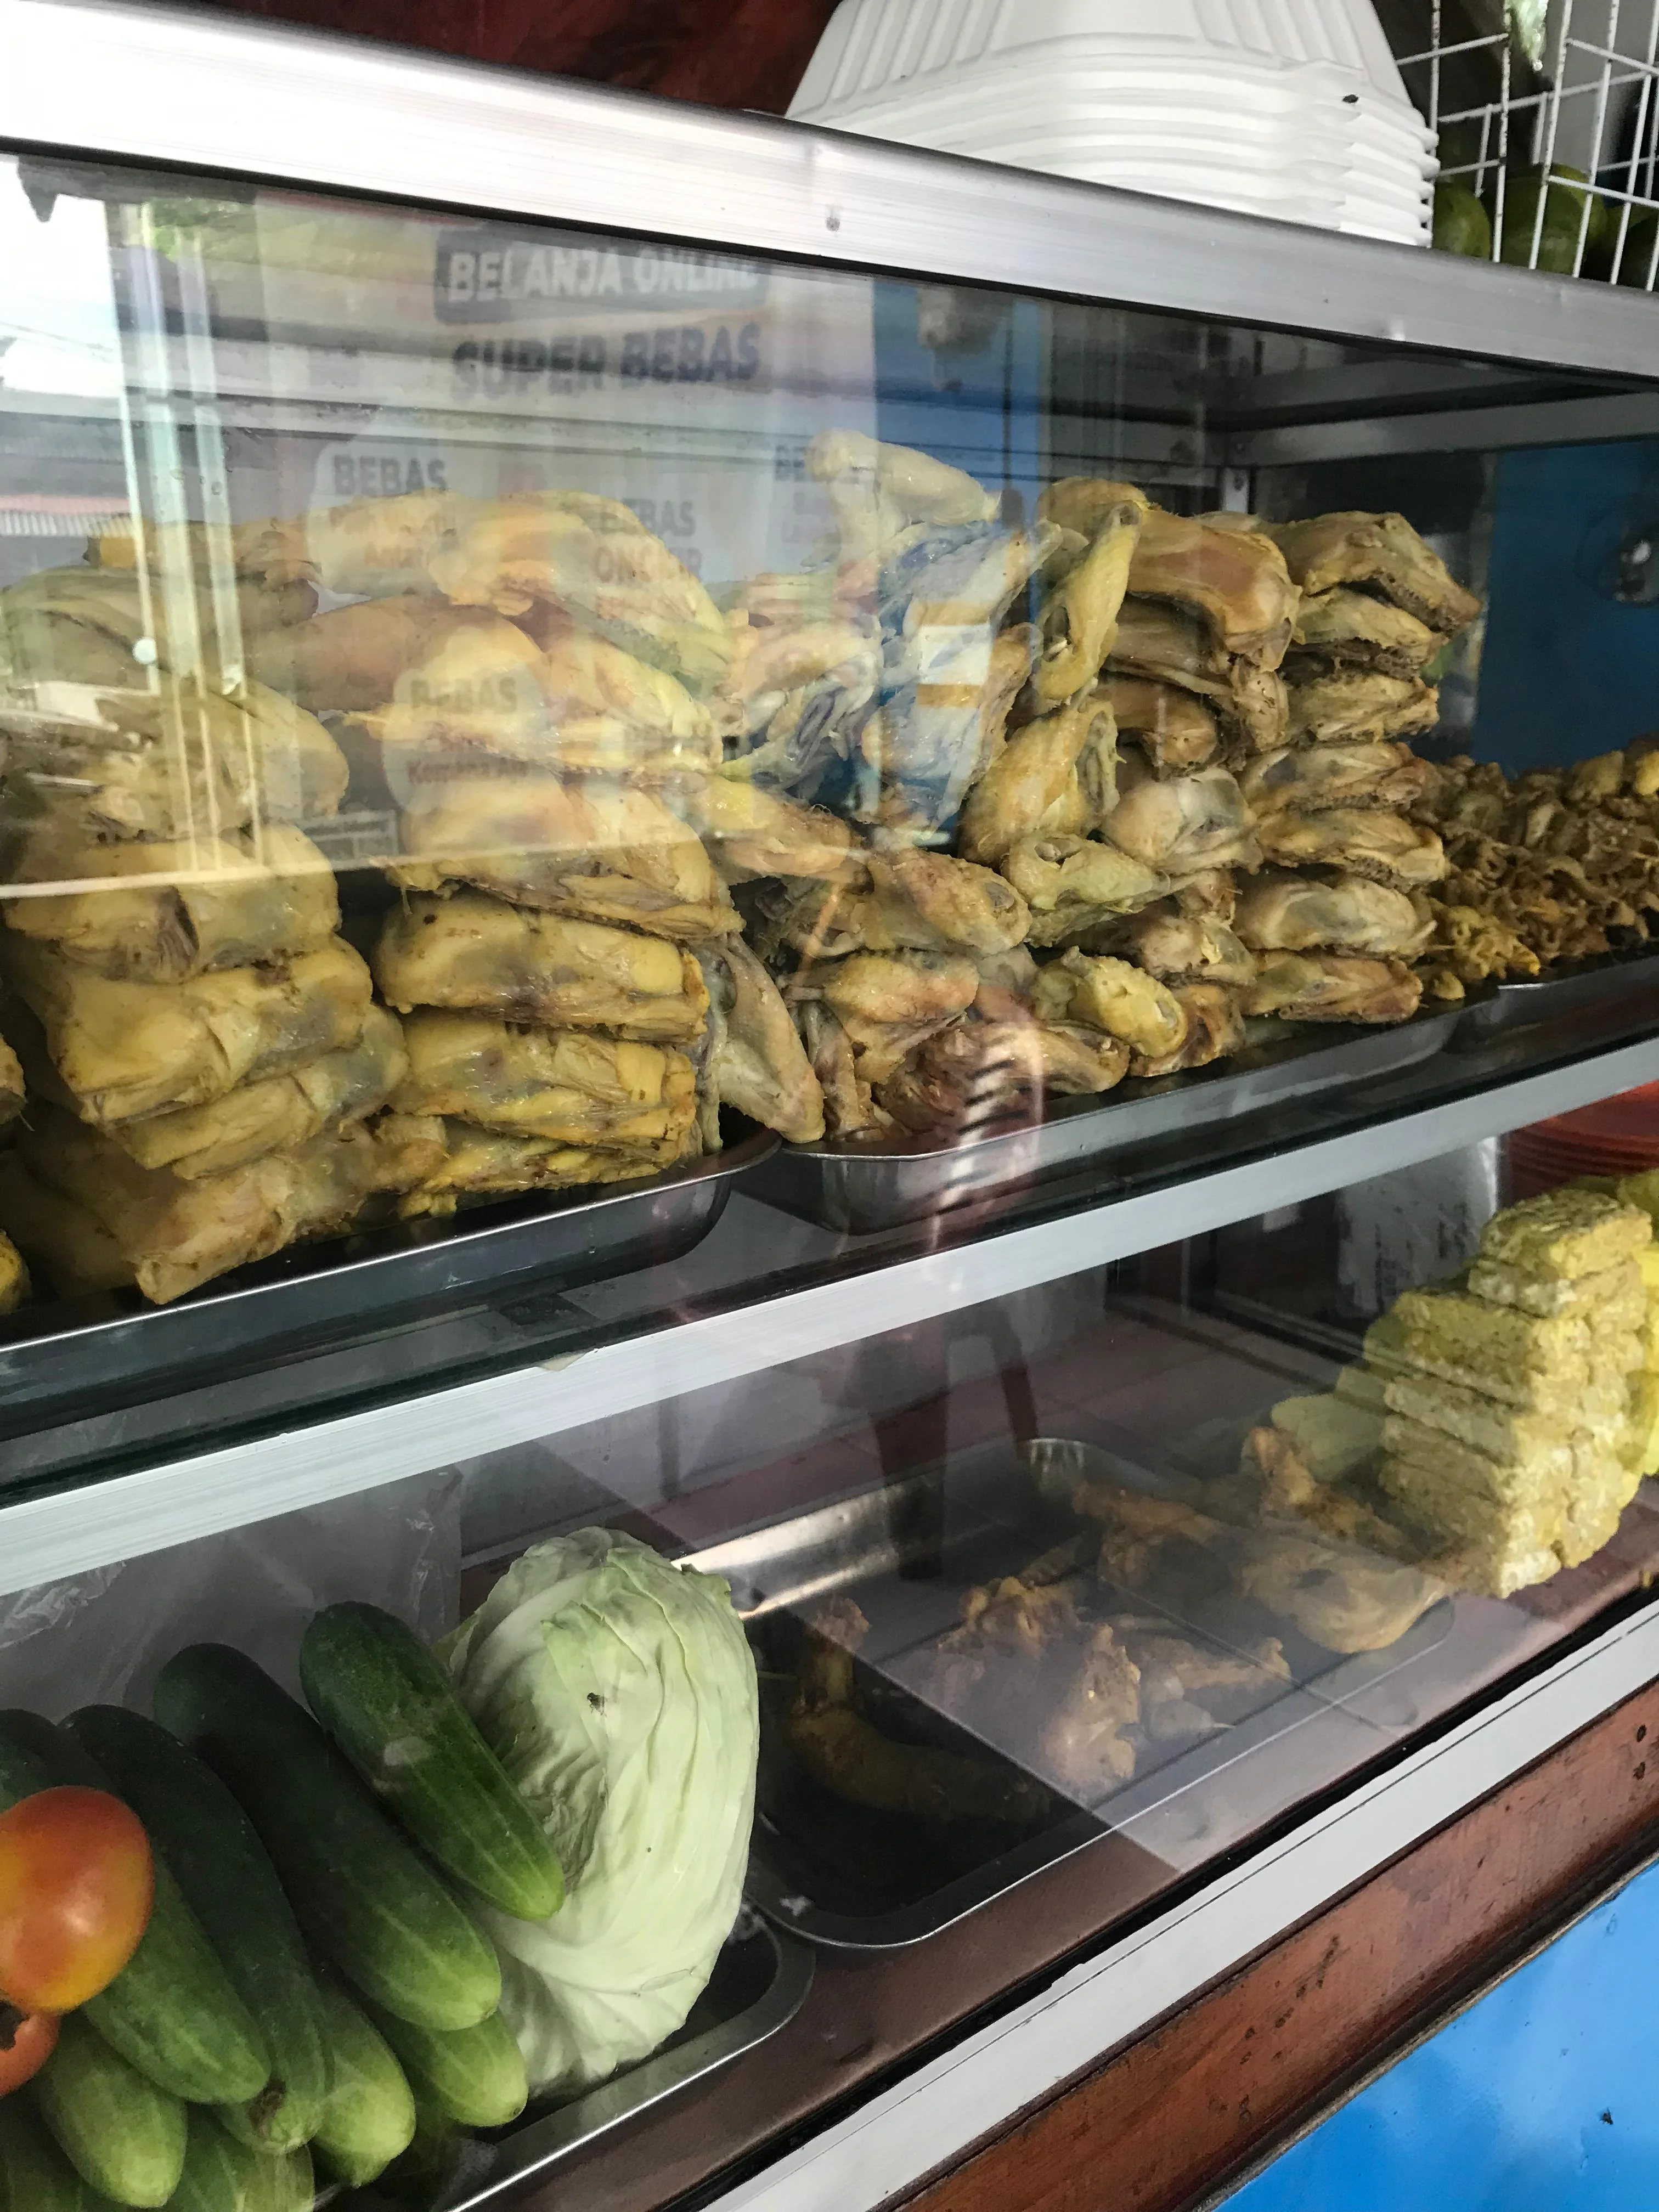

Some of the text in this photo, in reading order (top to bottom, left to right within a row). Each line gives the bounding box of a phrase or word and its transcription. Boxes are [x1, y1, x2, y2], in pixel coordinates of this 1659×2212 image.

[448, 246, 623, 303] BELANJA
[451, 321, 762, 402] SUPER BEBAS
[332, 454, 448, 497] BEBAS
